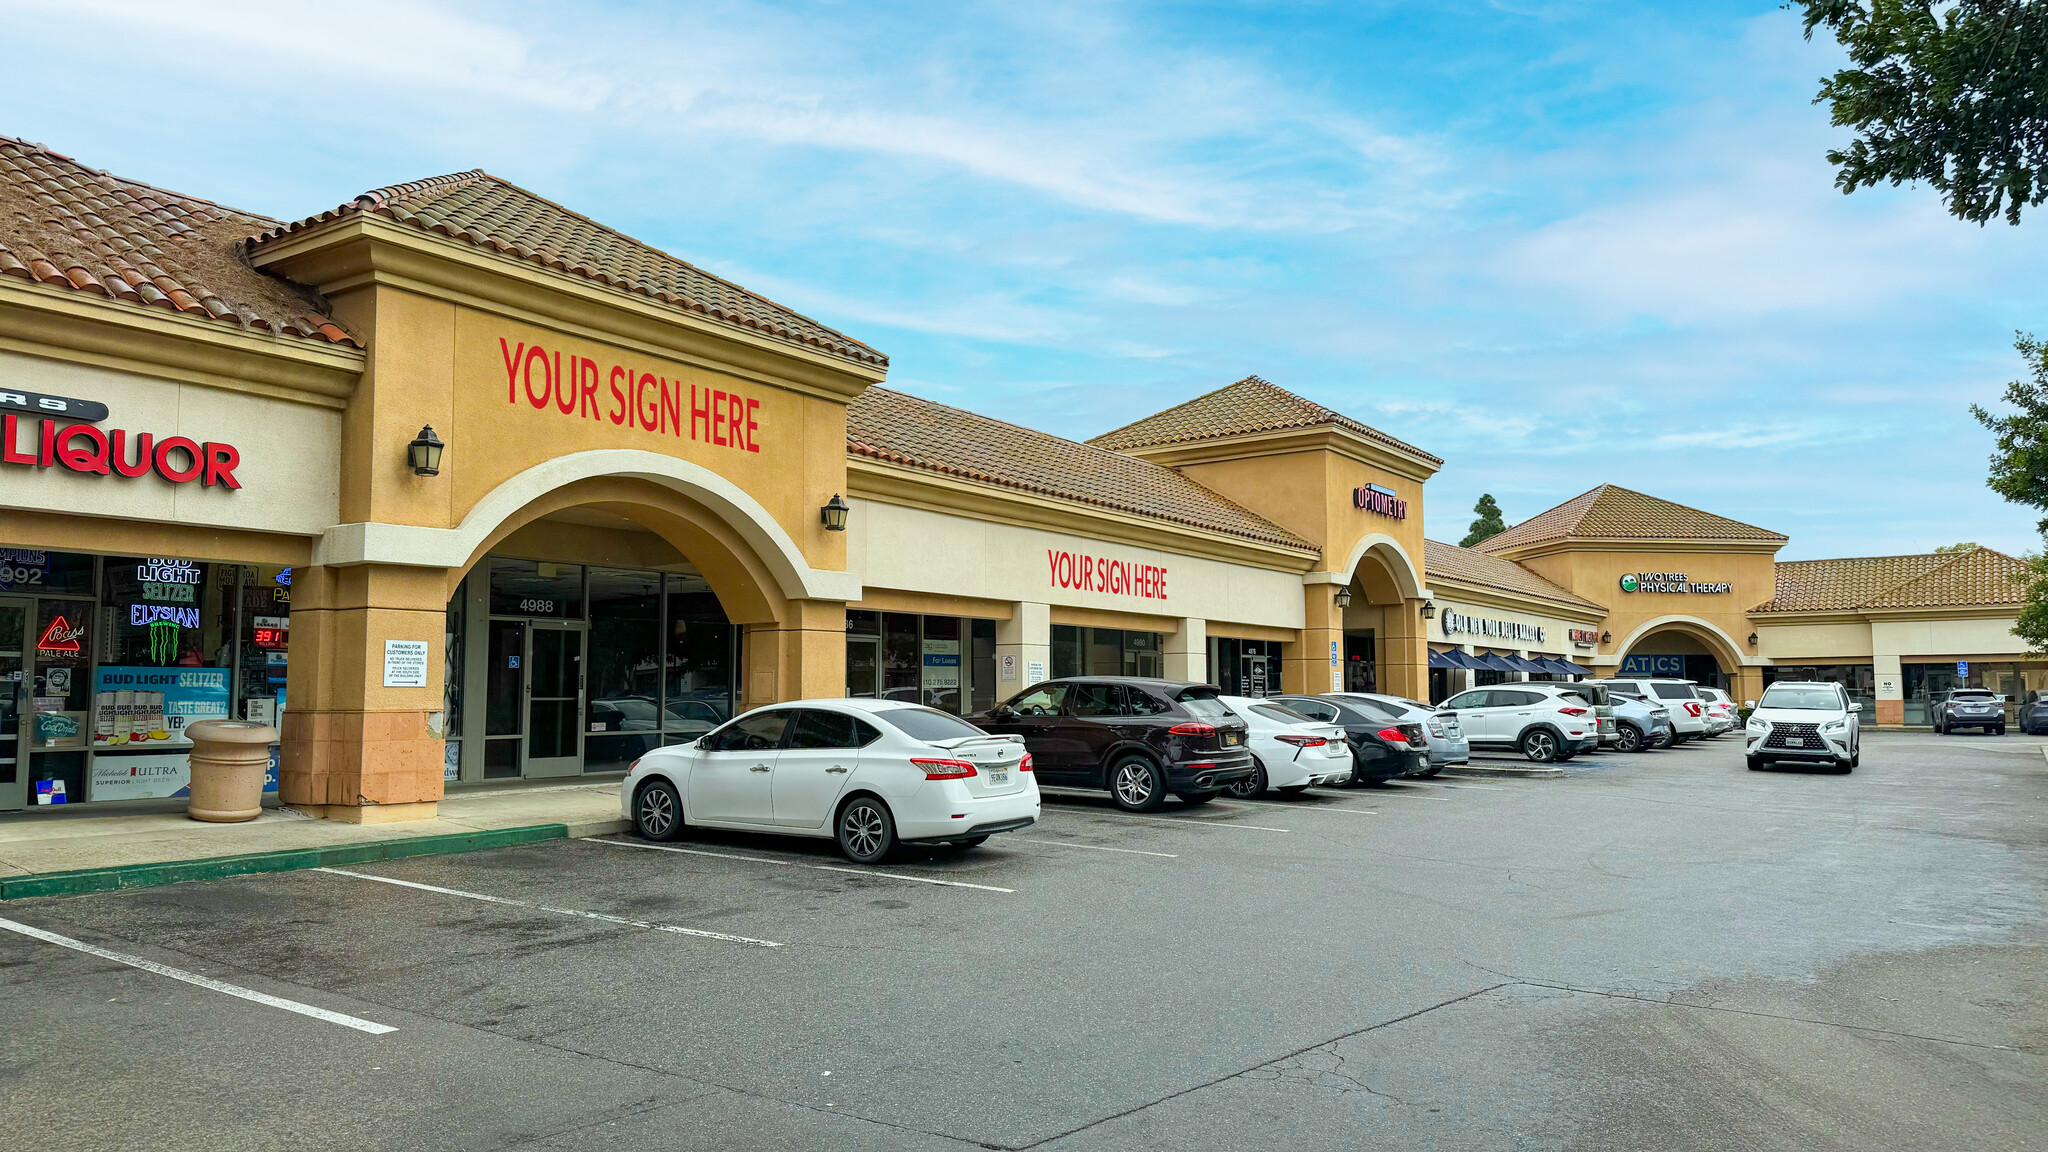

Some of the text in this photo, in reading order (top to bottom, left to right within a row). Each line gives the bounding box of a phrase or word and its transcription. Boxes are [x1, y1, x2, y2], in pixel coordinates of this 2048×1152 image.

[499, 337, 760, 453] YOUR SIGN HERE
[3, 413, 242, 489] LIQUOR
[1357, 487, 1407, 520] OPTOMETRY
[1048, 549, 1167, 600] YOUR SIGN HERE
[1640, 573, 1689, 582] TWO TREES
[142, 582, 194, 602] SELTZER
[1640, 582, 1733, 593] PHYSICAL THERAPY
[520, 599, 554, 612] 4988
[131, 604, 199, 628] ELYSIAN
[150, 620, 180, 629] BREWING
[49, 626, 85, 641] Bass
[255, 630, 280, 642] 391
[1625, 657, 1680, 671] ATICS
[103, 672, 223, 688] BUD LIGHT SELTZER
[168, 701, 226, 714] TASTE GREAT?
[41, 720, 58, 732] Cool
[168, 716, 185, 729] YEP.
[138, 767, 177, 776] ULTRA
